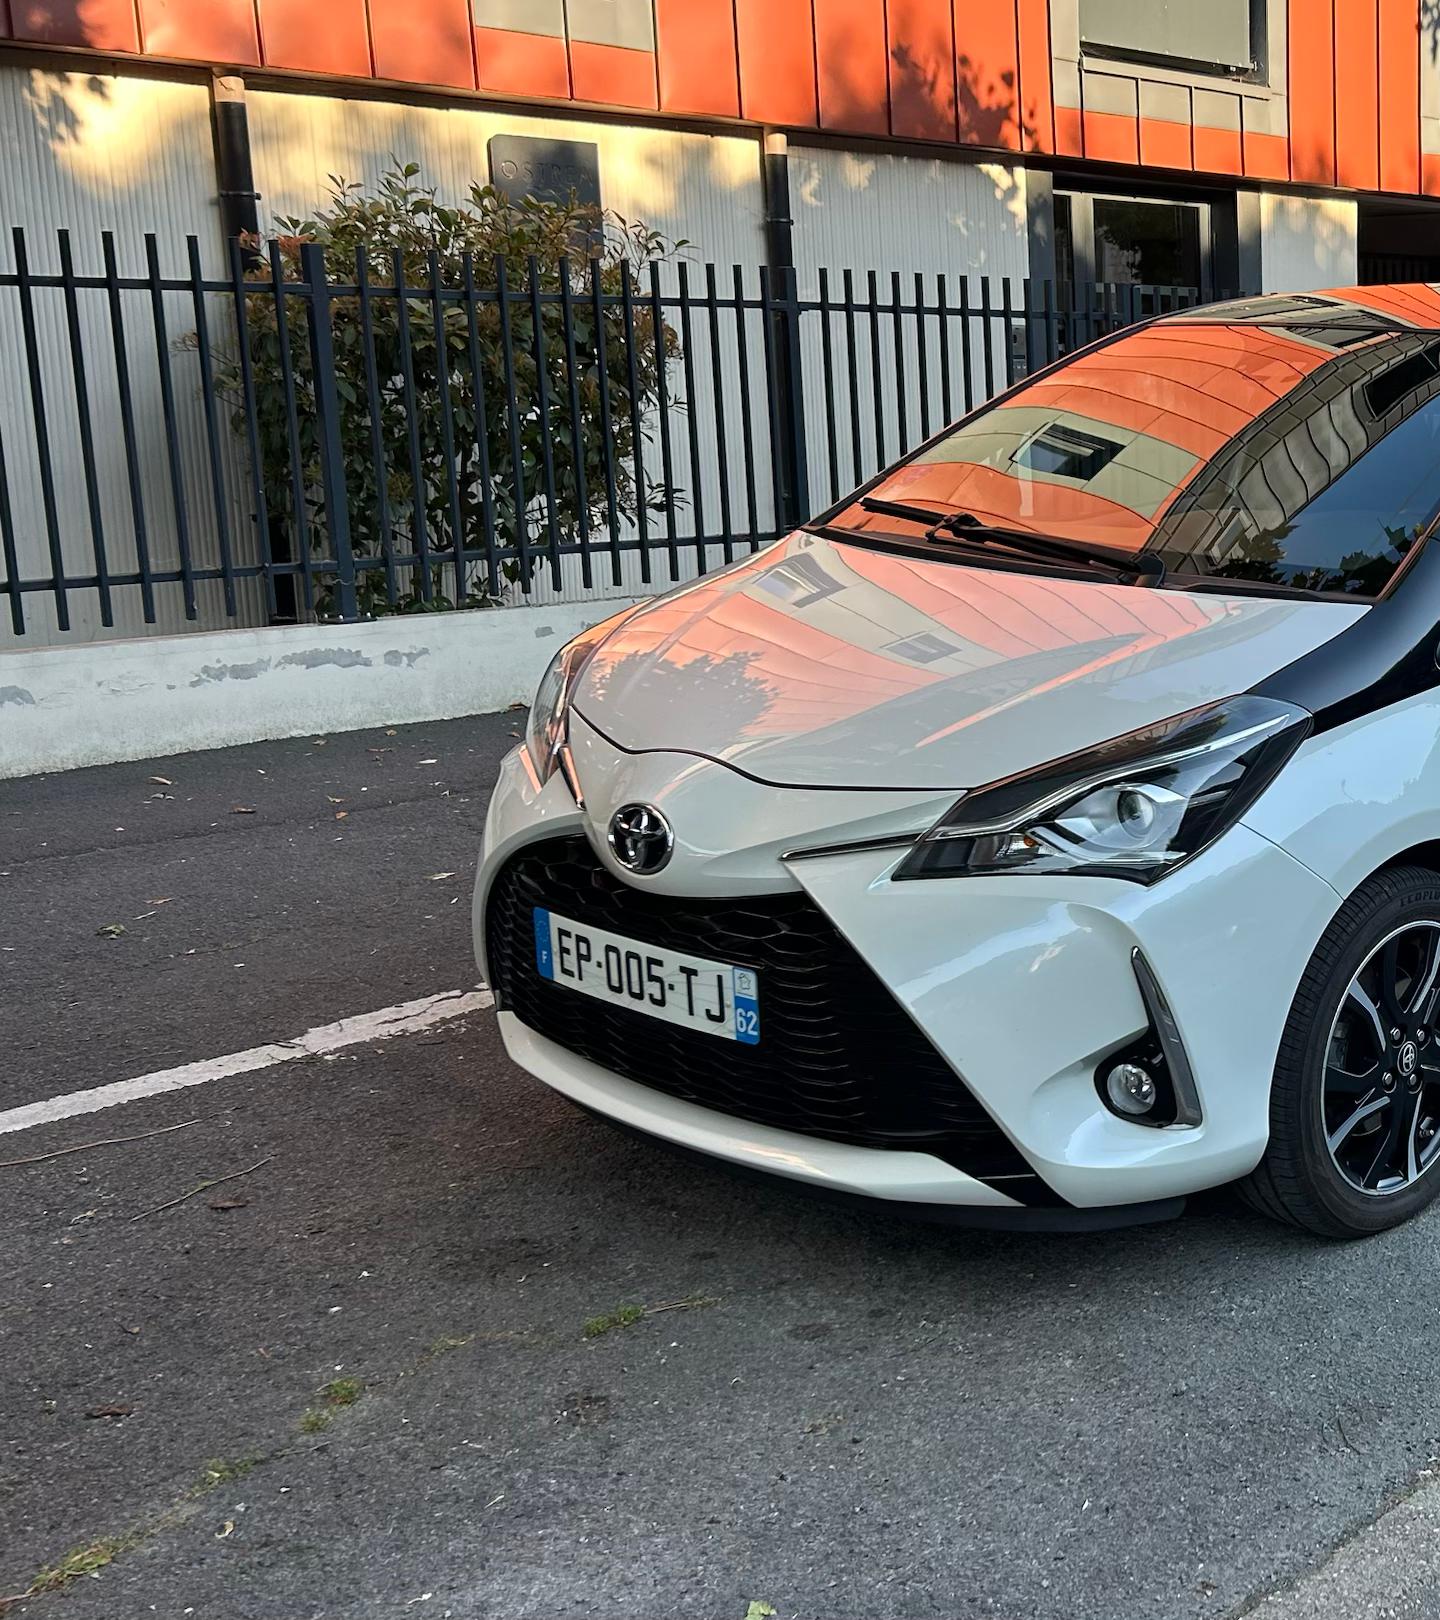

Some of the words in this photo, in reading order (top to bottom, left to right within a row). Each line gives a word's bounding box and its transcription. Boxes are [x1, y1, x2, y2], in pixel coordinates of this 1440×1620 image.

[541, 950, 548, 964] F
[557, 927, 726, 1023] EP-005-TJ
[736, 1007, 758, 1036] 62
